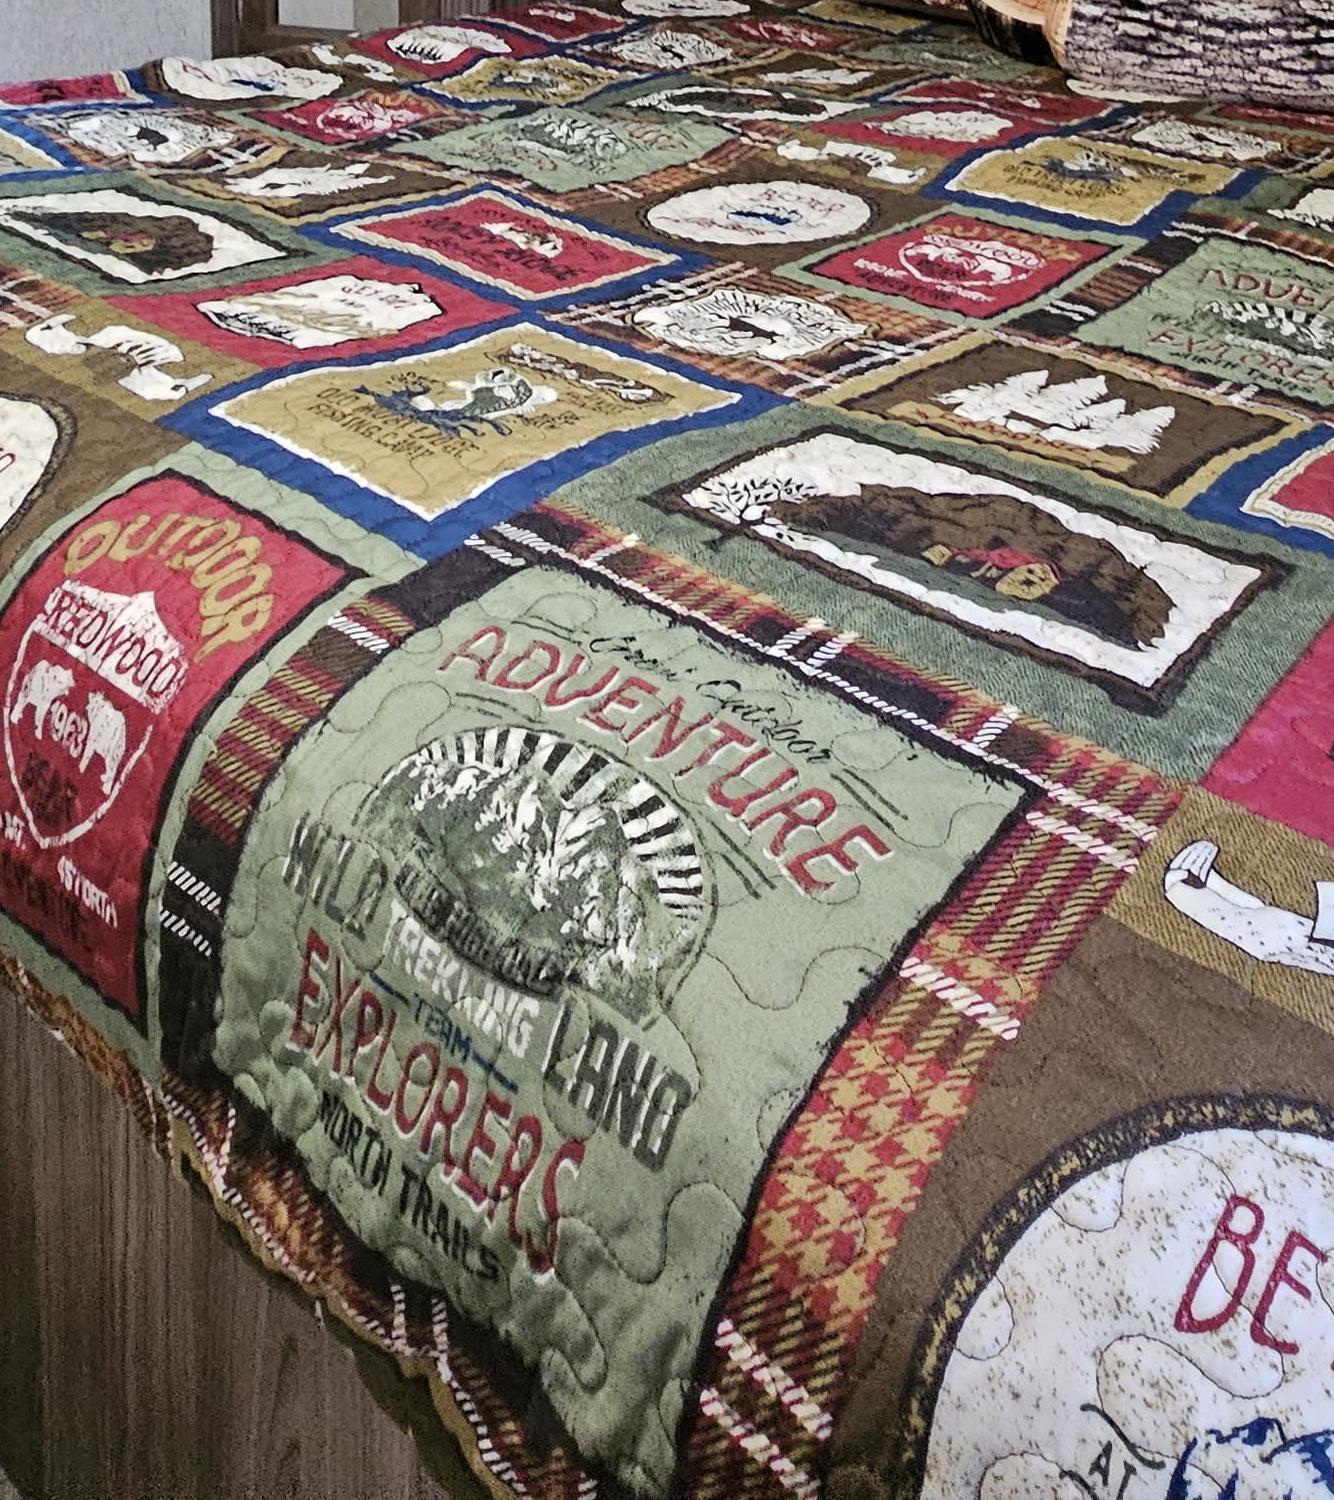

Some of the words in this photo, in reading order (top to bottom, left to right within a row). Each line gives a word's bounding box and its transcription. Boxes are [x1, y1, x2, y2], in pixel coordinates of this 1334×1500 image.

[63, 512, 275, 664] OUTDOOR
[437, 624, 894, 894] ADVENTURE
[284, 926, 586, 1284] EXPLORERS
[411, 992, 472, 1062] TEAM
[541, 998, 693, 1173] LAND
[319, 1090, 395, 1197] NORTH
[397, 1165, 500, 1281] TRAILS
